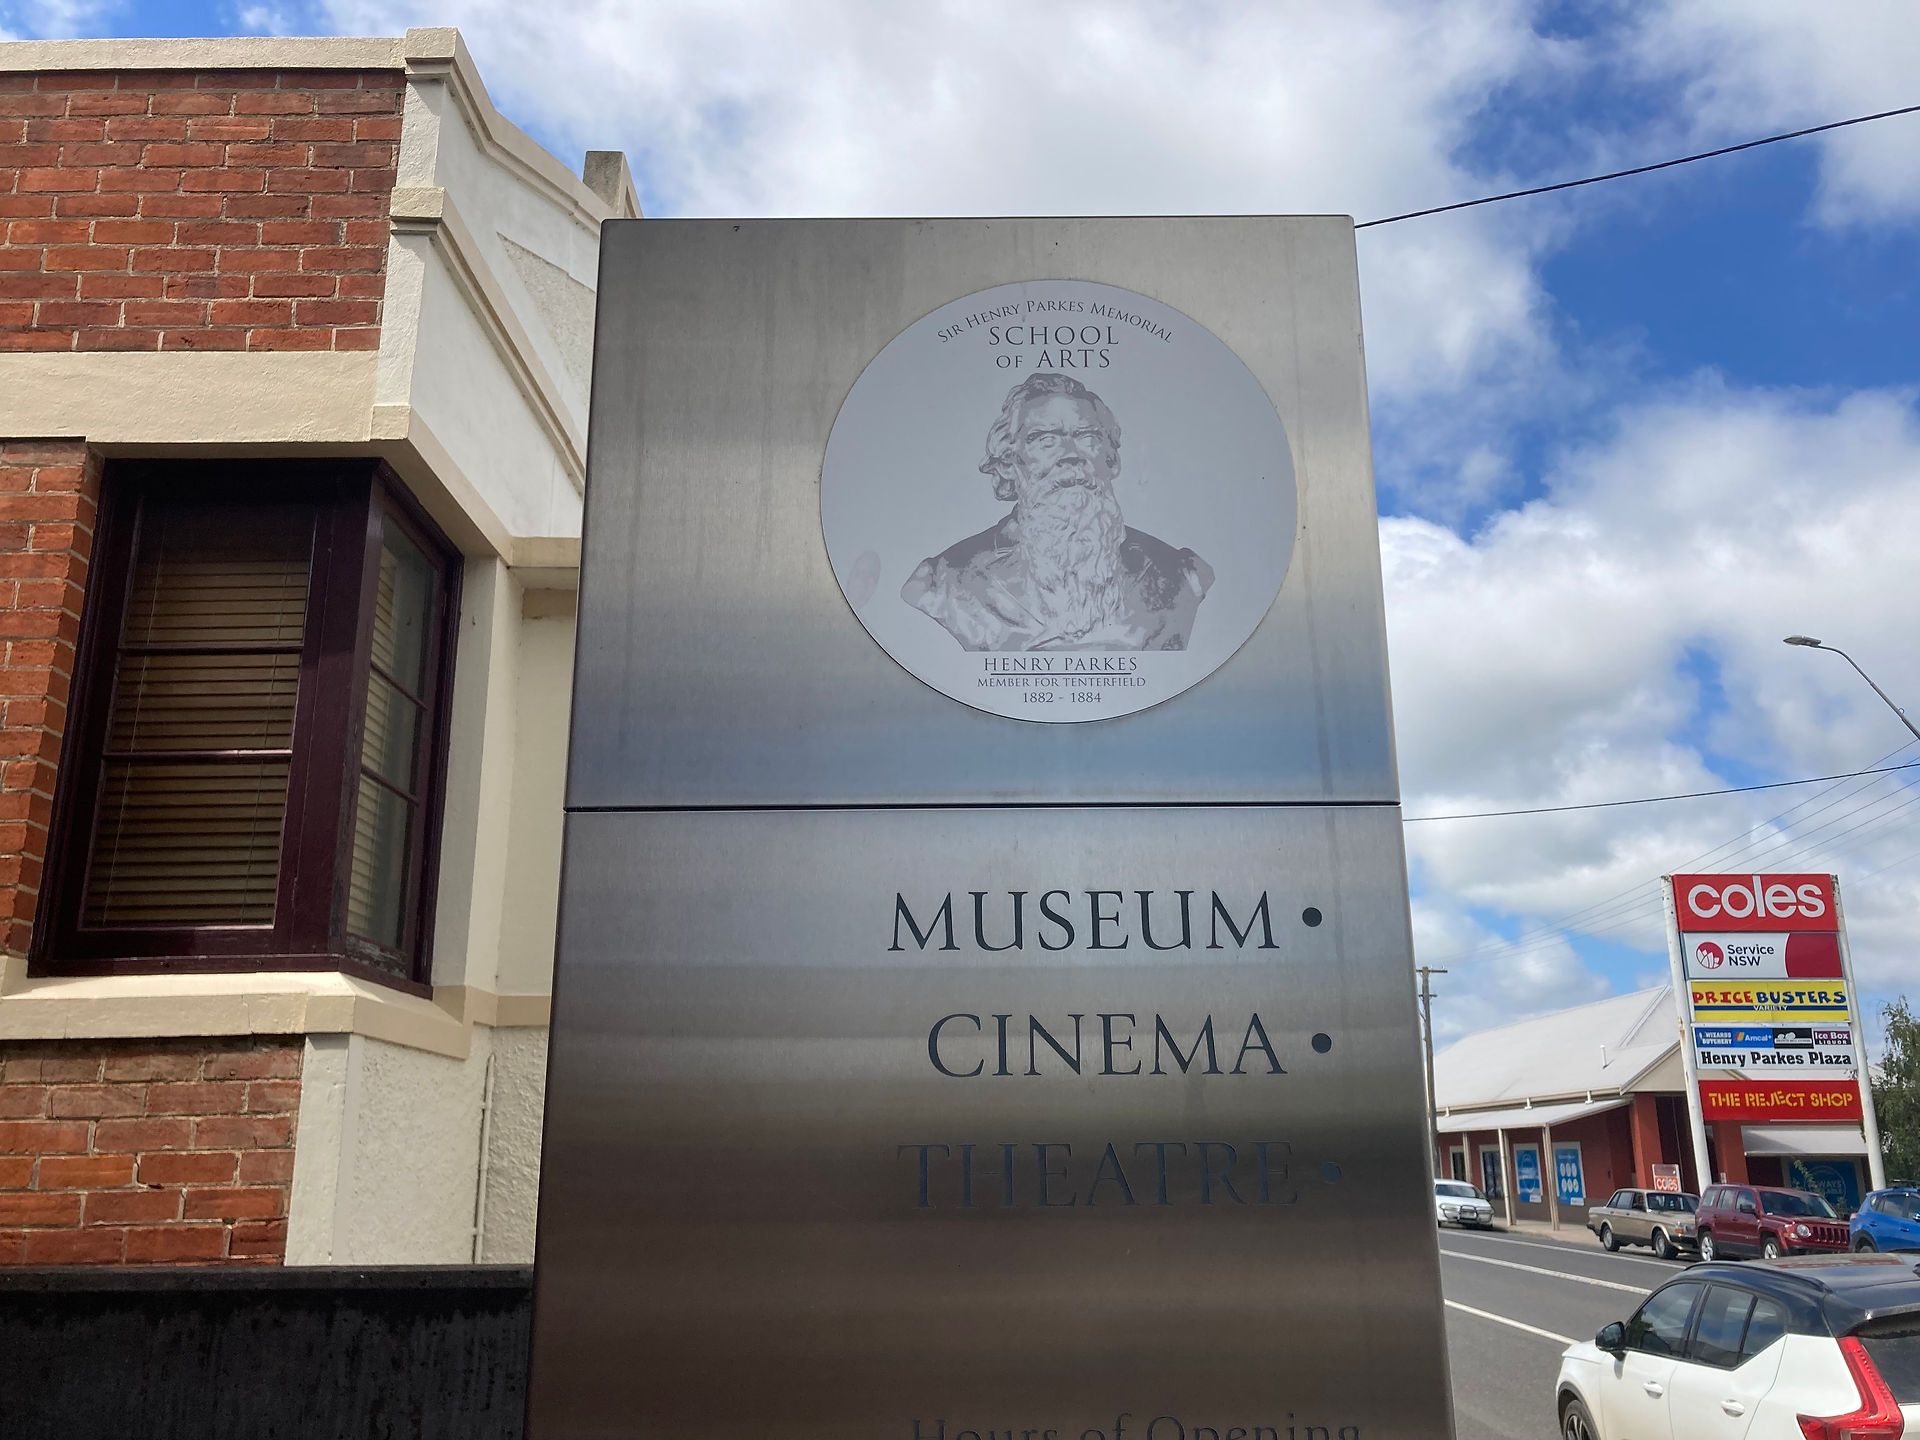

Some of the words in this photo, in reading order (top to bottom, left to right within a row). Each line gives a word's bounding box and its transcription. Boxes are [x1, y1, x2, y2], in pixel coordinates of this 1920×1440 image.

[966, 303, 1020, 328] HENRY
[1027, 300, 1084, 312] PARKES
[1090, 302, 1175, 343] MEMORIAL
[989, 326, 1119, 345] SCHOOL
[996, 354, 1023, 368] OF
[1037, 349, 1111, 368] ARTS
[984, 657, 1055, 671] HENRY
[1065, 657, 1137, 671] PARKES
[977, 677, 1030, 687] MEMBER
[1034, 677, 1059, 687] FOR
[1062, 677, 1146, 687] TENTERFIELD
[1023, 691, 1054, 703] 1882
[1071, 691, 1102, 703] 1884
[1687, 875, 1826, 919] coles
[888, 889, 1280, 952] MUSEUM
[1727, 944, 1774, 955] Service
[1728, 956, 1761, 966] NSW
[1692, 991, 1753, 1004] PRICE
[1756, 991, 1847, 1004] BUSTERS
[927, 1012, 1288, 1078] CINEMA
[1701, 1051, 1746, 1068] Henry
[1751, 1051, 1804, 1065] Parkes
[1809, 1051, 1852, 1065] Plaza
[1708, 1093, 1741, 1107] THE
[1745, 1090, 1805, 1107] REJECT
[1810, 1093, 1853, 1107] SHOP
[897, 1141, 1299, 1208] THEATRE
